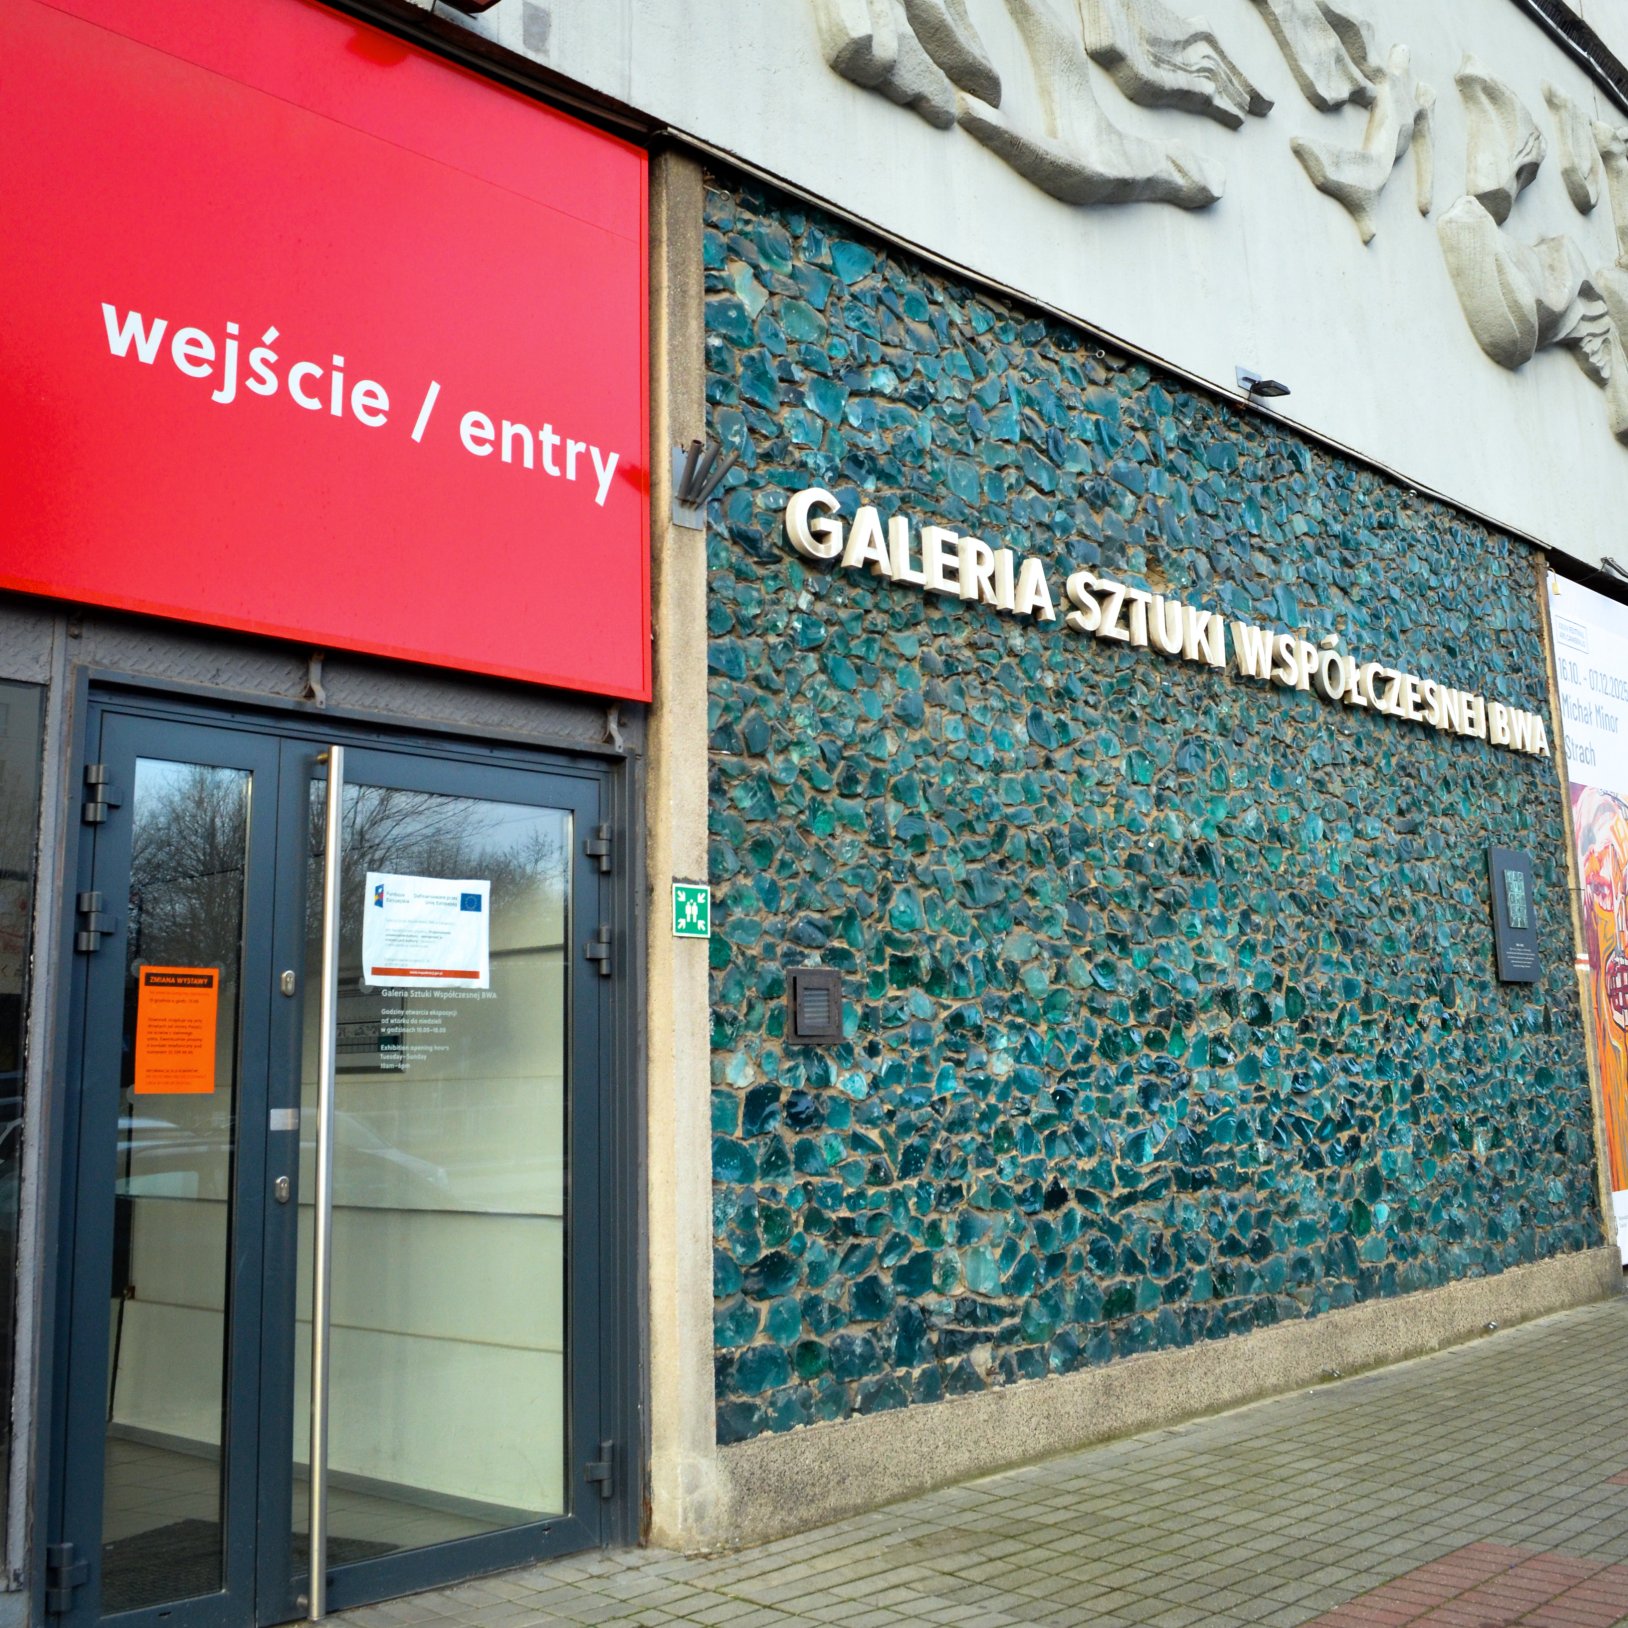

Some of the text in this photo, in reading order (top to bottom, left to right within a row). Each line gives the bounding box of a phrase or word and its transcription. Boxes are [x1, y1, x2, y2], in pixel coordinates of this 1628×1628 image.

[101, 302, 620, 506] wejście / entry
[785, 487, 1551, 757] GALERIA SZTUKI WSPÓŁCZESNEJ BWA
[1558, 657, 1581, 686] 16.10.
[1595, 703, 1619, 734] Minor
[1564, 735, 1596, 767] Strach
[381, 988, 497, 1000] Galeria Sztuki Współczesnej BWA
[381, 1008, 404, 1016] Godziny
